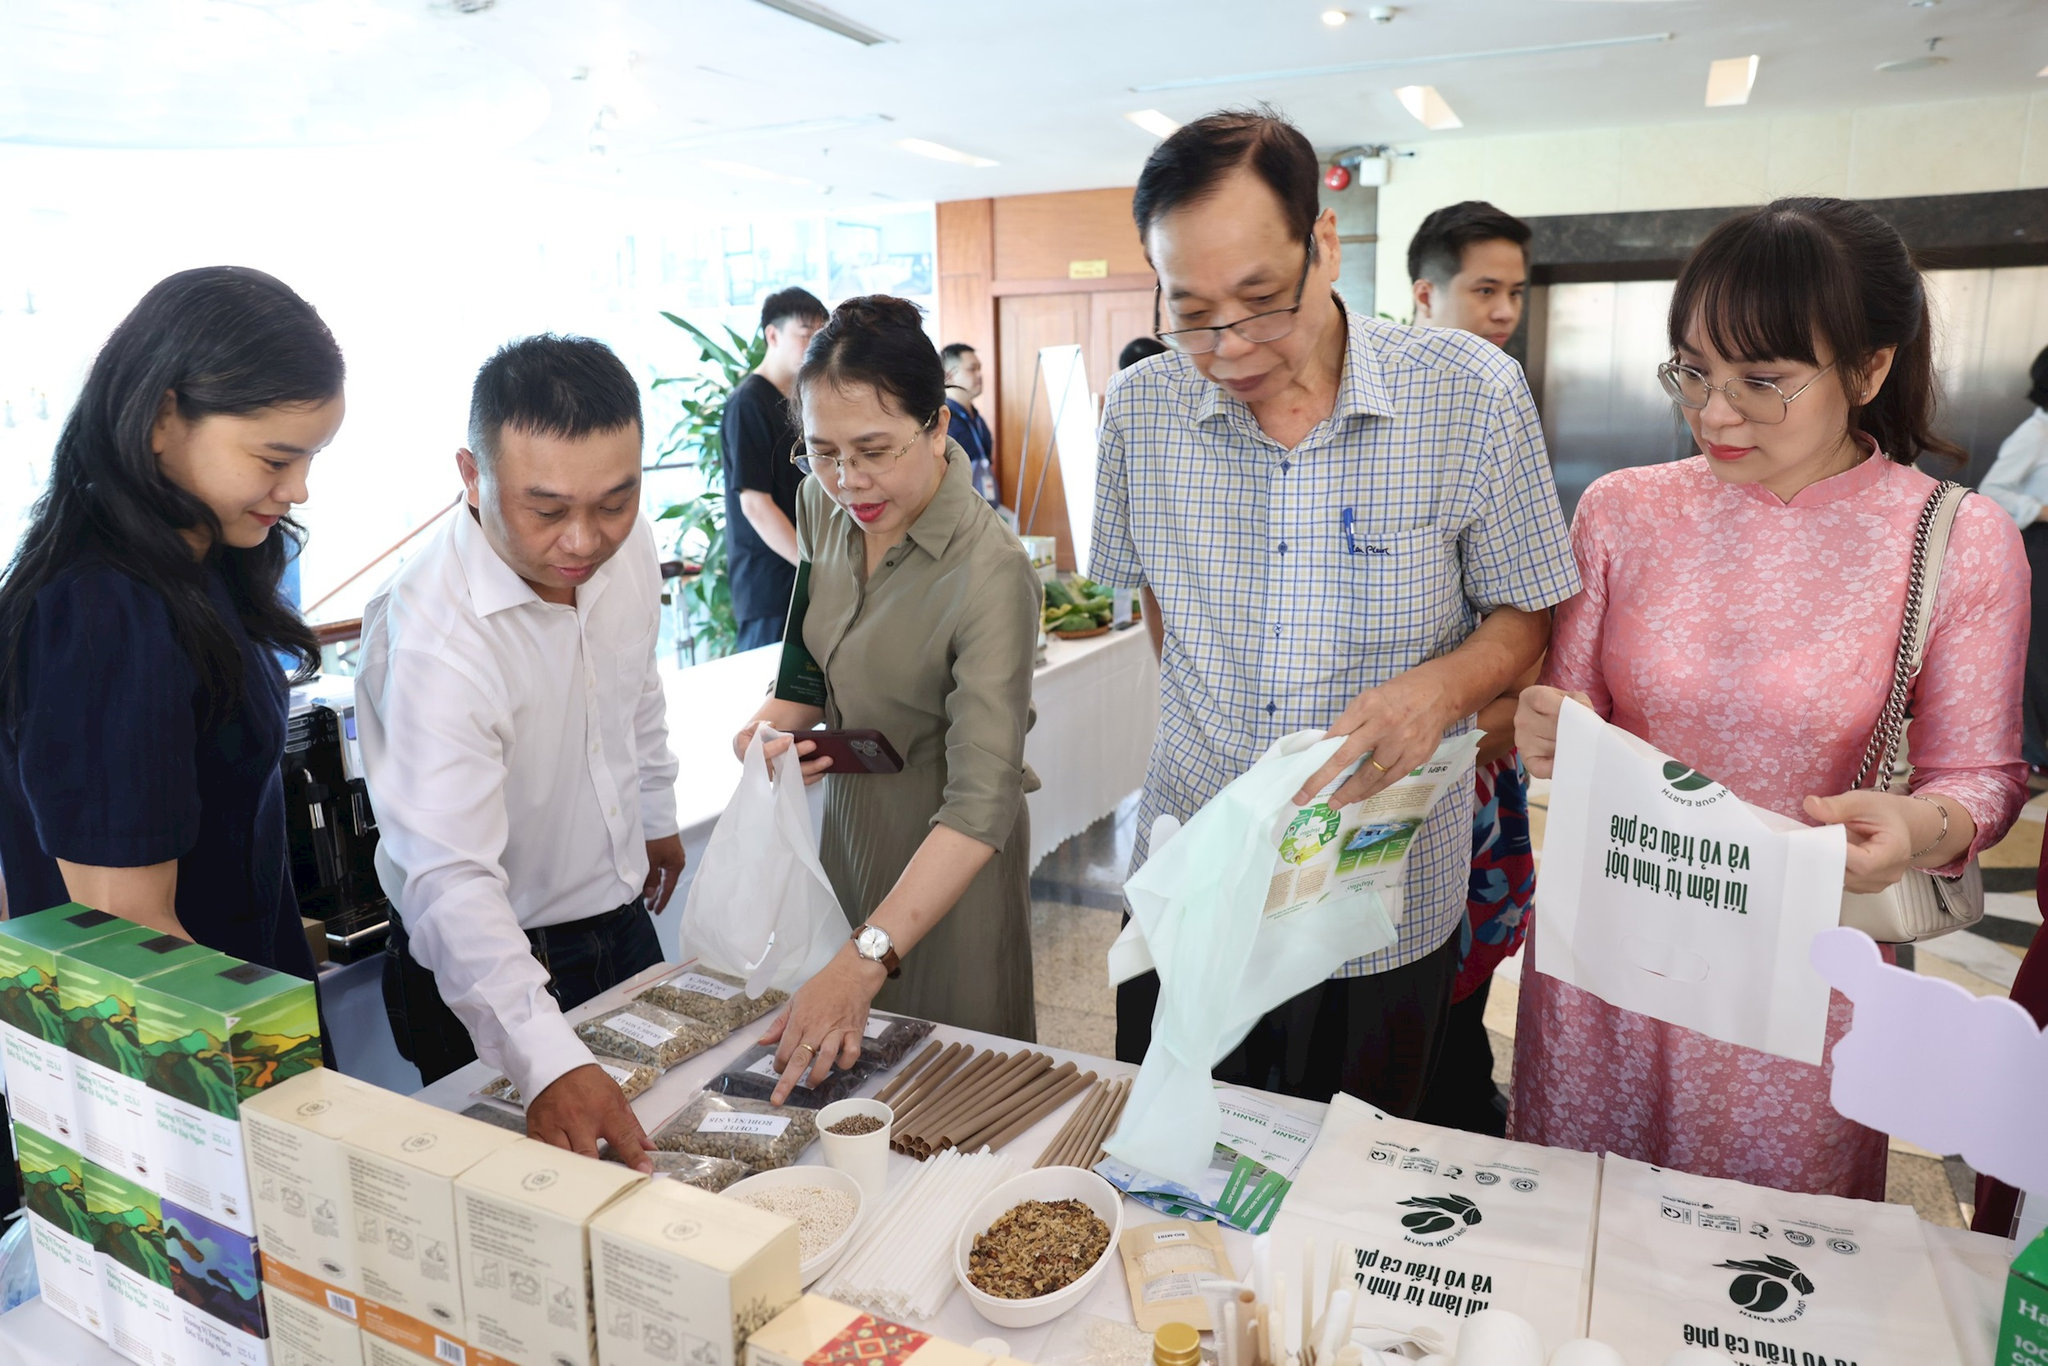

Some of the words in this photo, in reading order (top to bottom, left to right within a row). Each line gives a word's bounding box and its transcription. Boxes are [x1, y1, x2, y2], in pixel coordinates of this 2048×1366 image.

[1661, 788, 1692, 807] EARTH
[1695, 797, 1716, 807] OUR
[1610, 814, 1638, 846] phê
[1640, 823, 1657, 852] cà
[1660, 830, 1694, 866] trấu
[1700, 839, 1722, 870] vỏ
[1728, 843, 1750, 874] và
[1605, 846, 1629, 883] bột
[1633, 858, 1660, 894] tinh
[1664, 868, 1682, 900] từ
[1687, 874, 1720, 909] làm
[1724, 880, 1748, 914] Túi
[1436, 1236, 1454, 1247] OUR
[1355, 1248, 1380, 1269] ph
[1380, 1256, 1402, 1274] cà
[1404, 1262, 1441, 1286] trấu
[1444, 1270, 1466, 1290] vỏ
[1472, 1274, 1492, 1295] và
[1367, 1276, 1402, 1301] tinh
[1404, 1285, 1425, 1306] từ
[1428, 1291, 1463, 1317] làm
[1794, 1300, 1806, 1316] LOVE
[1739, 1310, 1775, 1324] EARTH
[1778, 1315, 1797, 1324] OUR
[1684, 1324, 1719, 1348] phê
[1725, 1334, 1749, 1355] cà
